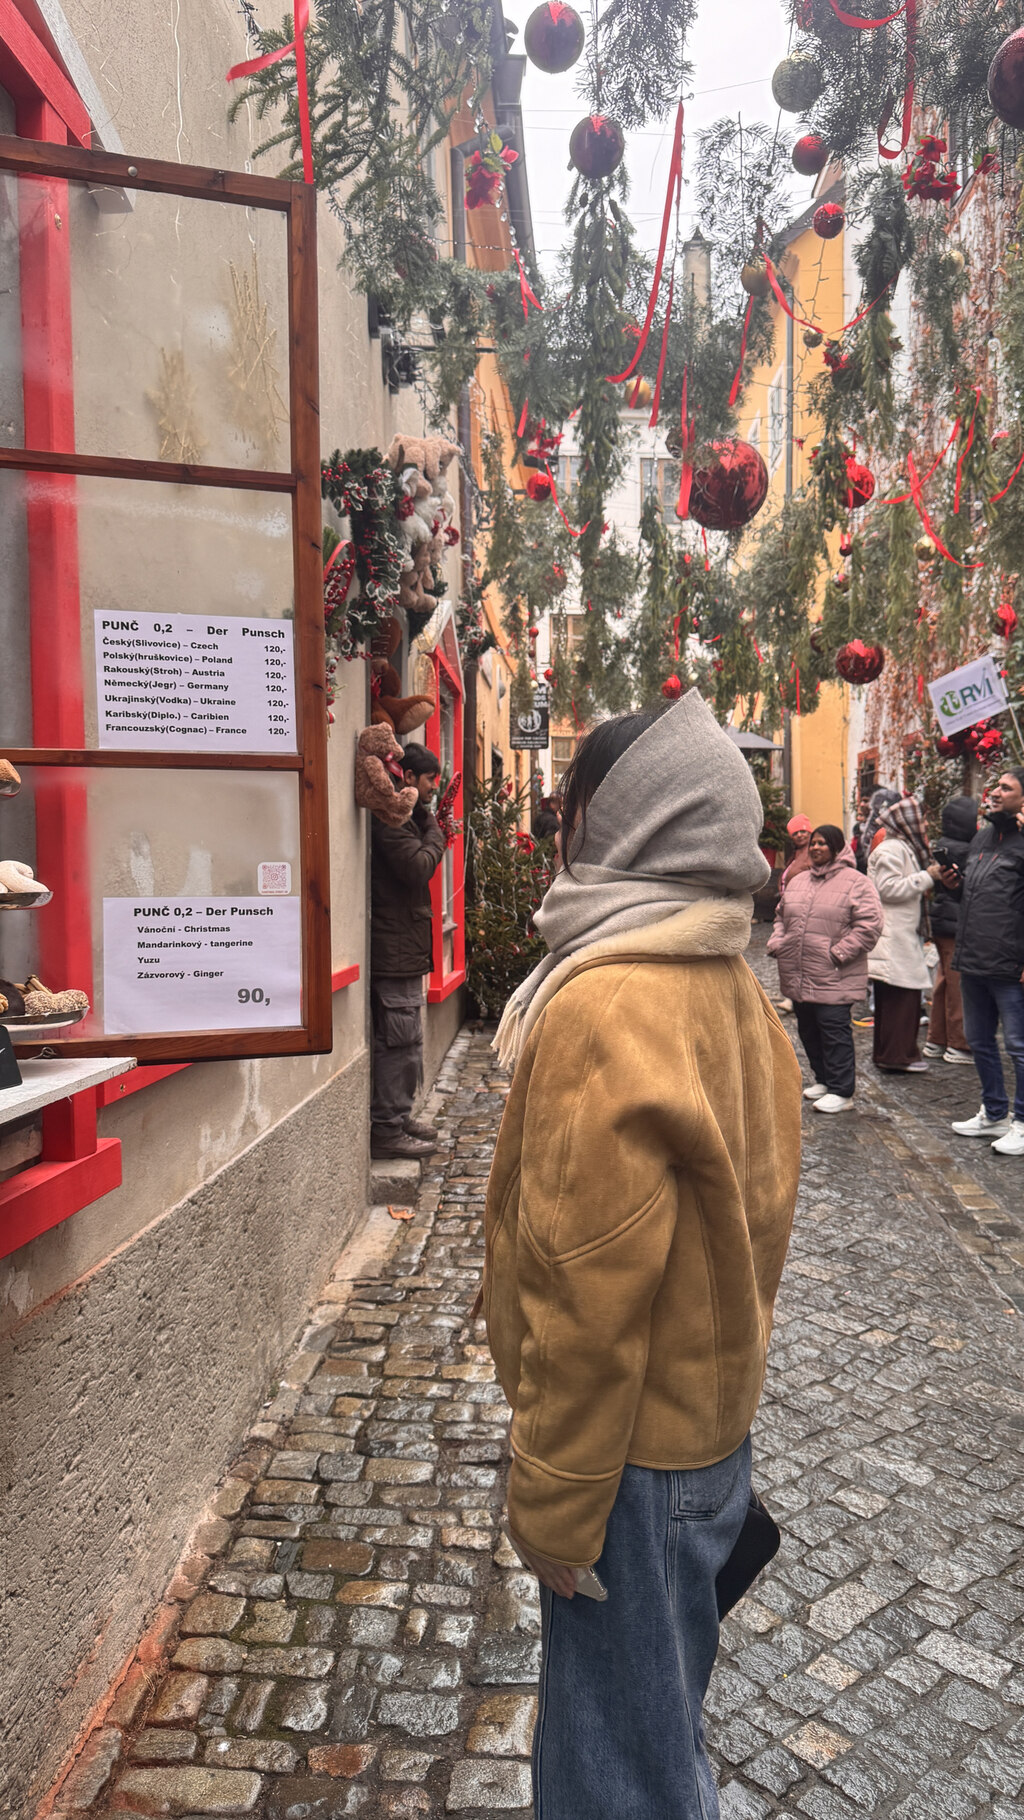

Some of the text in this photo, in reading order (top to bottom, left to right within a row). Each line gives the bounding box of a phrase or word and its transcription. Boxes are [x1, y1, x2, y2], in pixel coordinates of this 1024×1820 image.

[102, 619, 139, 632] PUNČ
[153, 623, 173, 635] 0,2
[207, 626, 228, 636] Der
[241, 627, 285, 639] Punsch
[102, 637, 181, 650] Český(Slivovice)
[190, 642, 219, 650] Czech
[264, 645, 286, 653] 120,-
[103, 652, 193, 664] Polský(hruškovice)
[201, 656, 233, 664] Poland
[264, 659, 287, 667] 120,-
[103, 665, 183, 677] Rakouský(Stroh)
[192, 669, 225, 677] Austria
[265, 672, 287, 680] 120,-
[104, 679, 177, 690] Německý(Jegr)
[187, 682, 229, 692] Germany
[265, 685, 287, 693] 120,-
[104, 695, 192, 706] Ukrajinský(Vodka)
[200, 698, 236, 706] Ukraine
[267, 700, 289, 708] 120,-
[105, 710, 181, 721] Karibský(Diplo.)
[190, 712, 230, 721] Caribien
[268, 715, 290, 723] 120,-
[105, 723, 208, 735] Francouzský(Cognac)
[215, 726, 247, 735] France
[268, 728, 290, 736] 120,-
[133, 906, 170, 917] PUNČ
[174, 907, 193, 918] 0,2
[205, 907, 227, 916] Der
[230, 907, 274, 916] Punsch
[137, 925, 176, 933] Vánoční
[184, 925, 231, 933] Christmas
[137, 940, 202, 949] Mandarinkový
[210, 940, 253, 948] tangerine
[137, 956, 160, 964] Yuzu
[137, 970, 185, 980] Zázvorový
[193, 970, 224, 979] Ginger
[237, 988, 271, 1006] 90,
